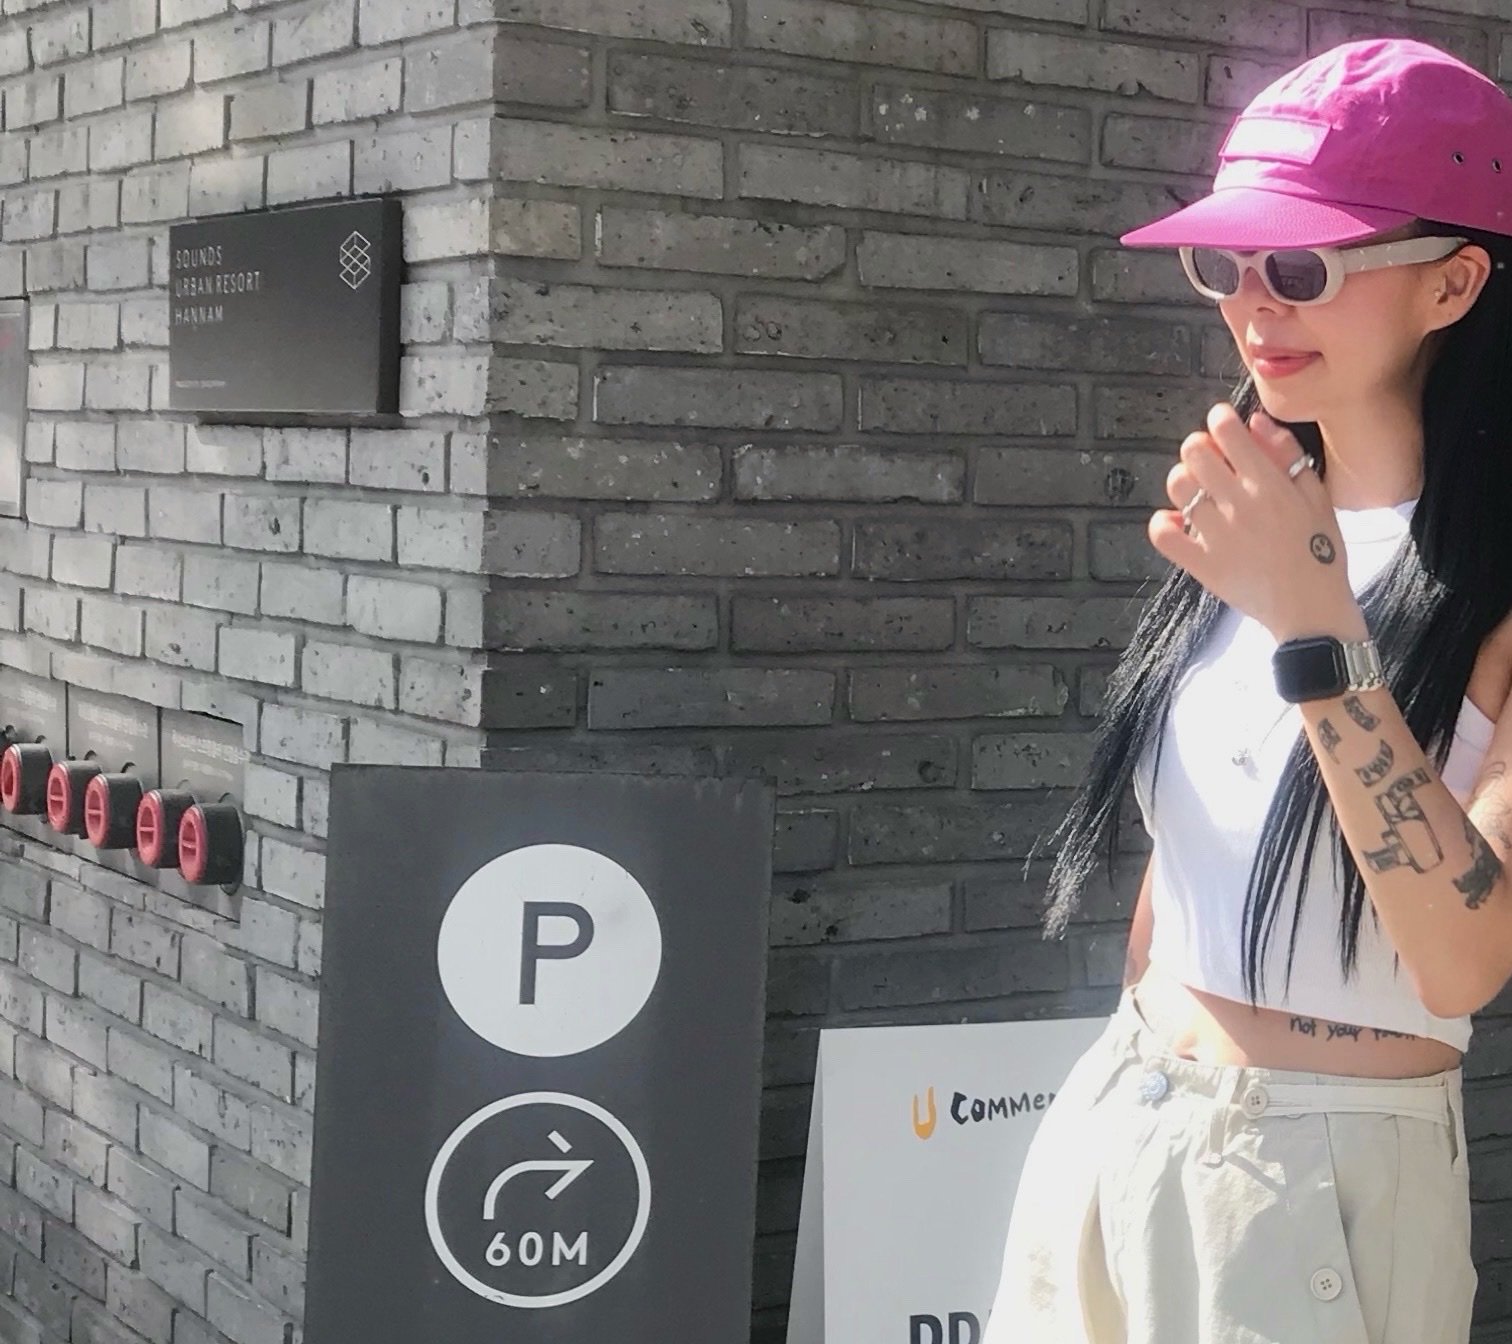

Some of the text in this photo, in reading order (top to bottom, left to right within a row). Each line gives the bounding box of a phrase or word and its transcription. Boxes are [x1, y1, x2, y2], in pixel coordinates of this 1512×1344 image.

[176, 245, 222, 269] SOUNDS
[175, 271, 260, 298] URBAN RESORT
[175, 305, 223, 325] HANNAM
[519, 901, 595, 1006] P
[485, 1231, 588, 1267] 60M
